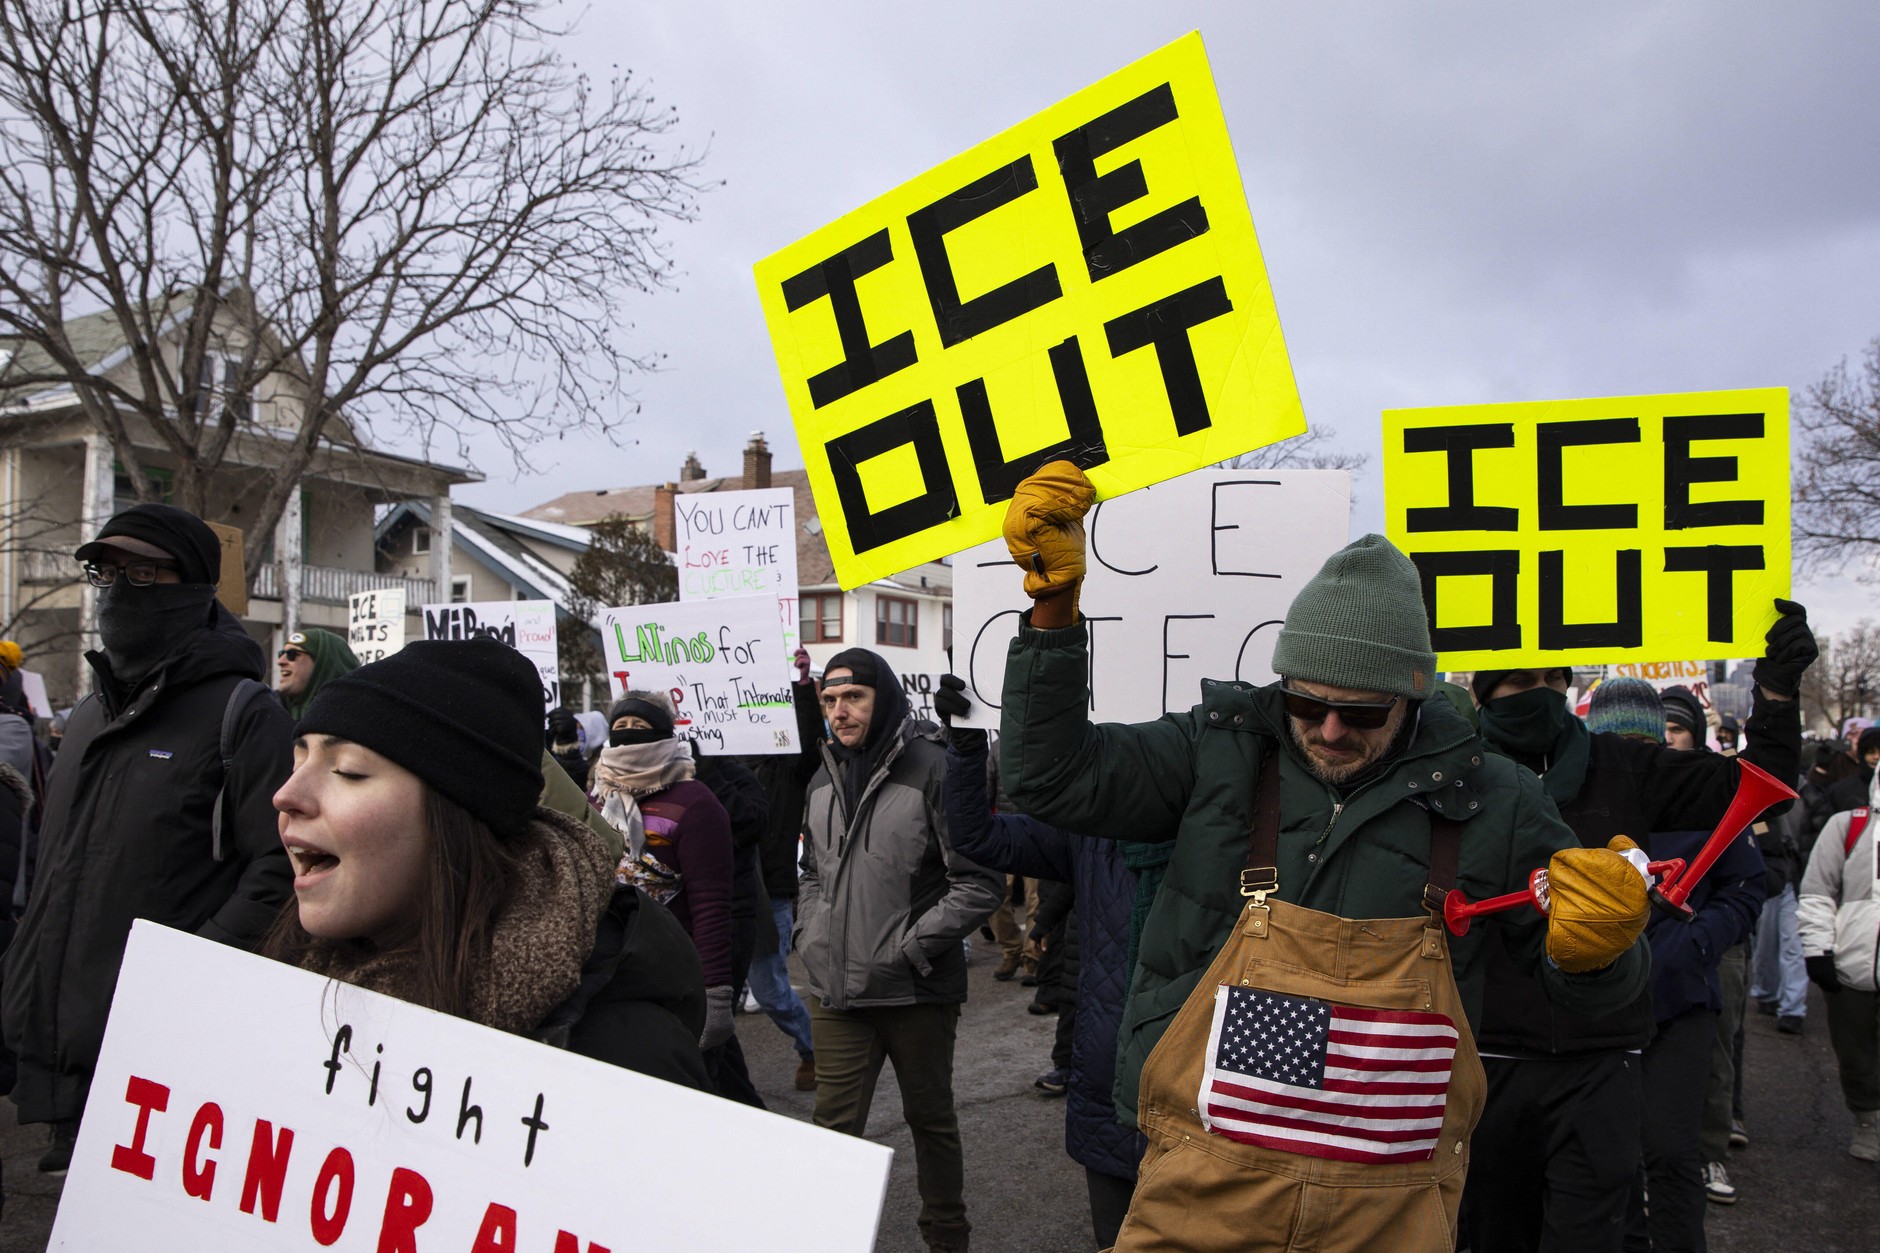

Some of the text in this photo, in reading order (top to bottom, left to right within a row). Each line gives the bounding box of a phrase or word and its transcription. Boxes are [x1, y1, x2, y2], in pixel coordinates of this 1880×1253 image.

[781, 81, 1210, 410] ICE
[824, 275, 1234, 555] OUT
[1404, 413, 1765, 533] ICE
[677, 502, 790, 540] YOU CAN'T
[977, 480, 1282, 578] CE
[685, 545, 779, 568] LOVE THE
[685, 568, 767, 595] CULTURE
[1409, 545, 1765, 652] OUT
[352, 594, 377, 623] ICE
[719, 626, 761, 664] for
[690, 683, 728, 711] That
[902, 674, 931, 692] NO
[748, 709, 771, 724] be
[324, 1024, 550, 1167] fight
